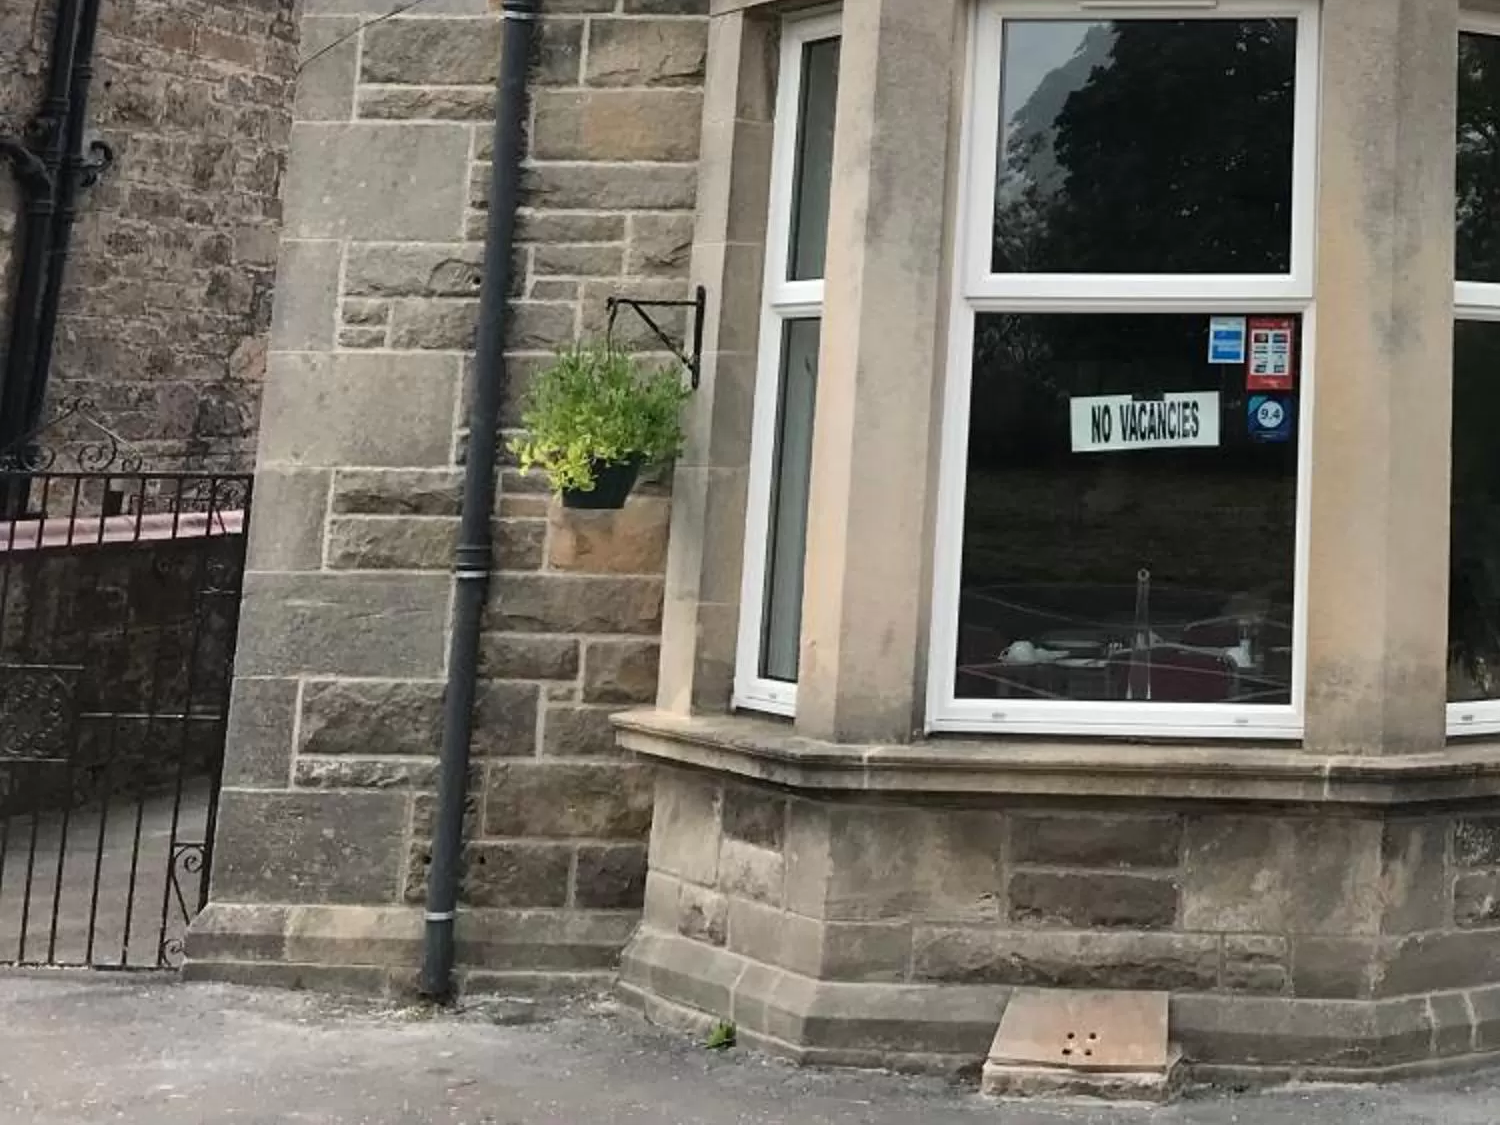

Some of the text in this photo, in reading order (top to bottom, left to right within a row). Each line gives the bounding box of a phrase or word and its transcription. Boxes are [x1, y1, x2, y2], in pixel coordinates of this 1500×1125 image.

[1091, 400, 1200, 443] NO VACANCIES
[1260, 407, 1281, 421] 9.4
